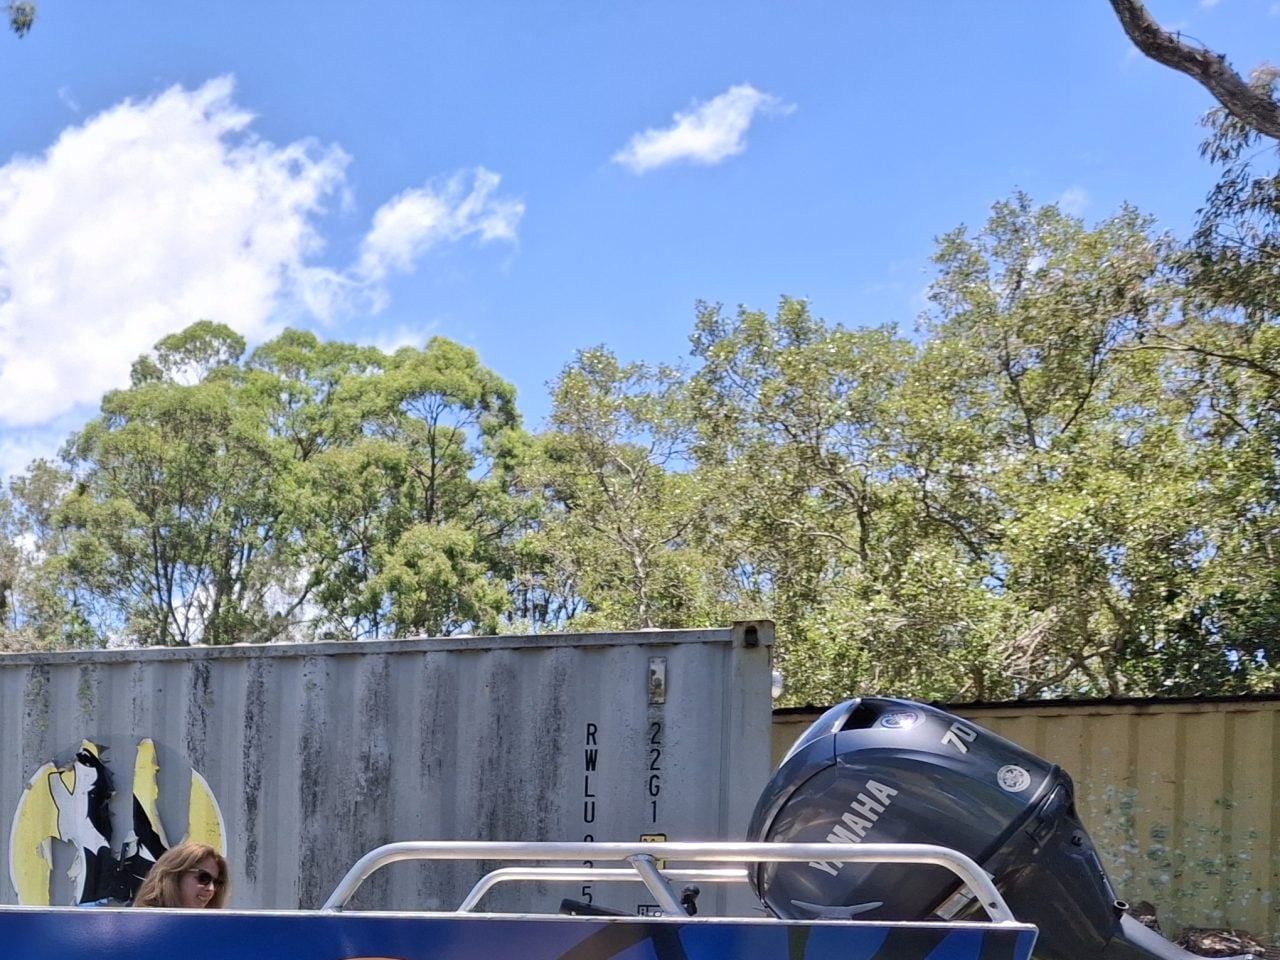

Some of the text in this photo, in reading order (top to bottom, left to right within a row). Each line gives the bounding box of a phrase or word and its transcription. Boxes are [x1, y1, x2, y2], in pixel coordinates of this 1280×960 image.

[648, 722, 662, 823] 22G1
[941, 722, 978, 754] 70
[809, 779, 899, 877] YMAHA
